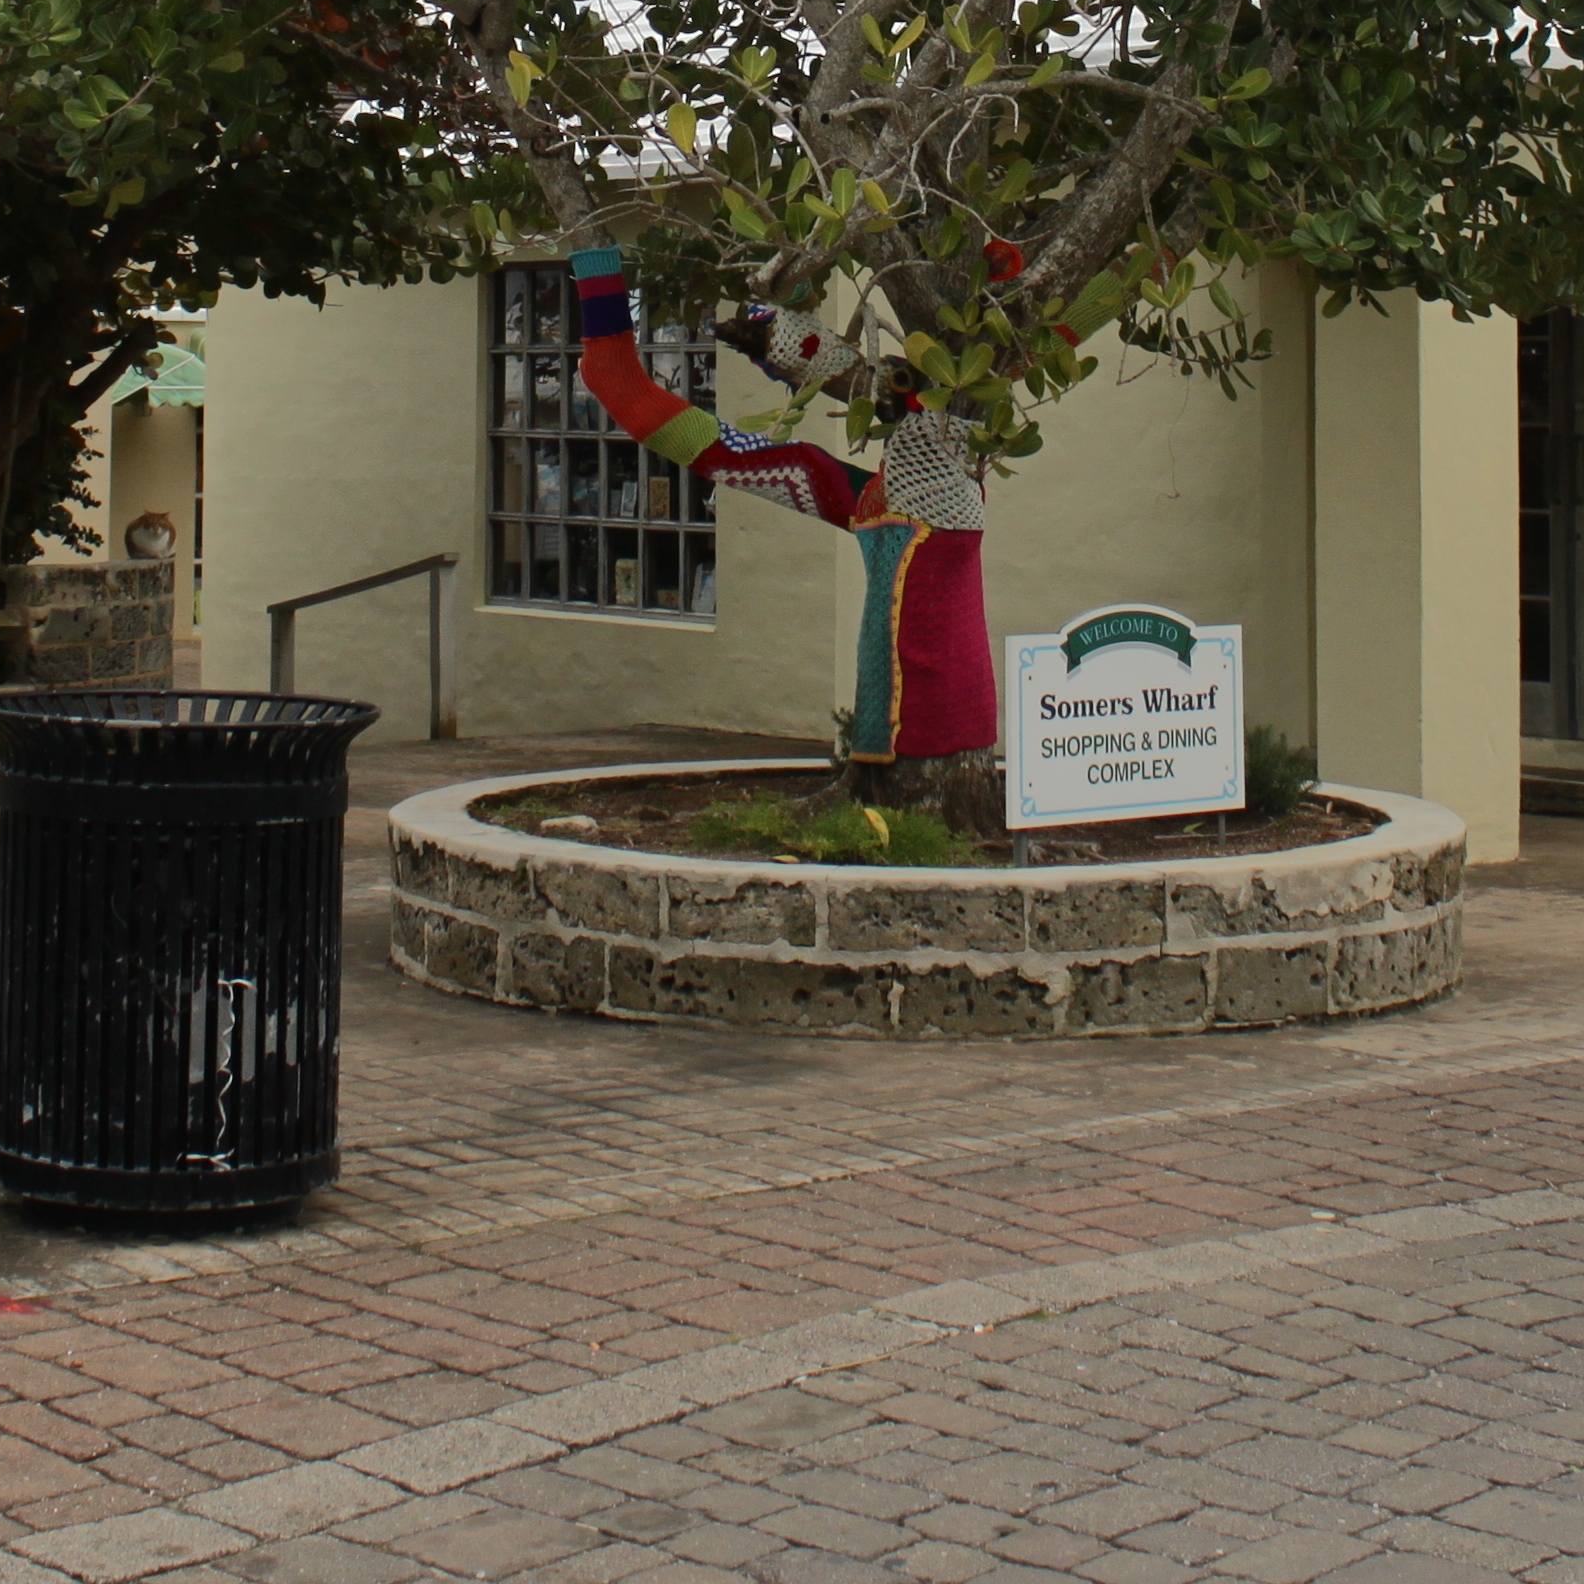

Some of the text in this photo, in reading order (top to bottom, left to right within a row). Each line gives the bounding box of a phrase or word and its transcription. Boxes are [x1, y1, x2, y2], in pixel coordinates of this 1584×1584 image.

[1079, 618, 1178, 645] WELCOME TO
[1040, 685, 1218, 720] Somers Wharf
[1042, 727, 1217, 758] SHOPPING & DINING
[1087, 759, 1175, 784] COMPLEX
